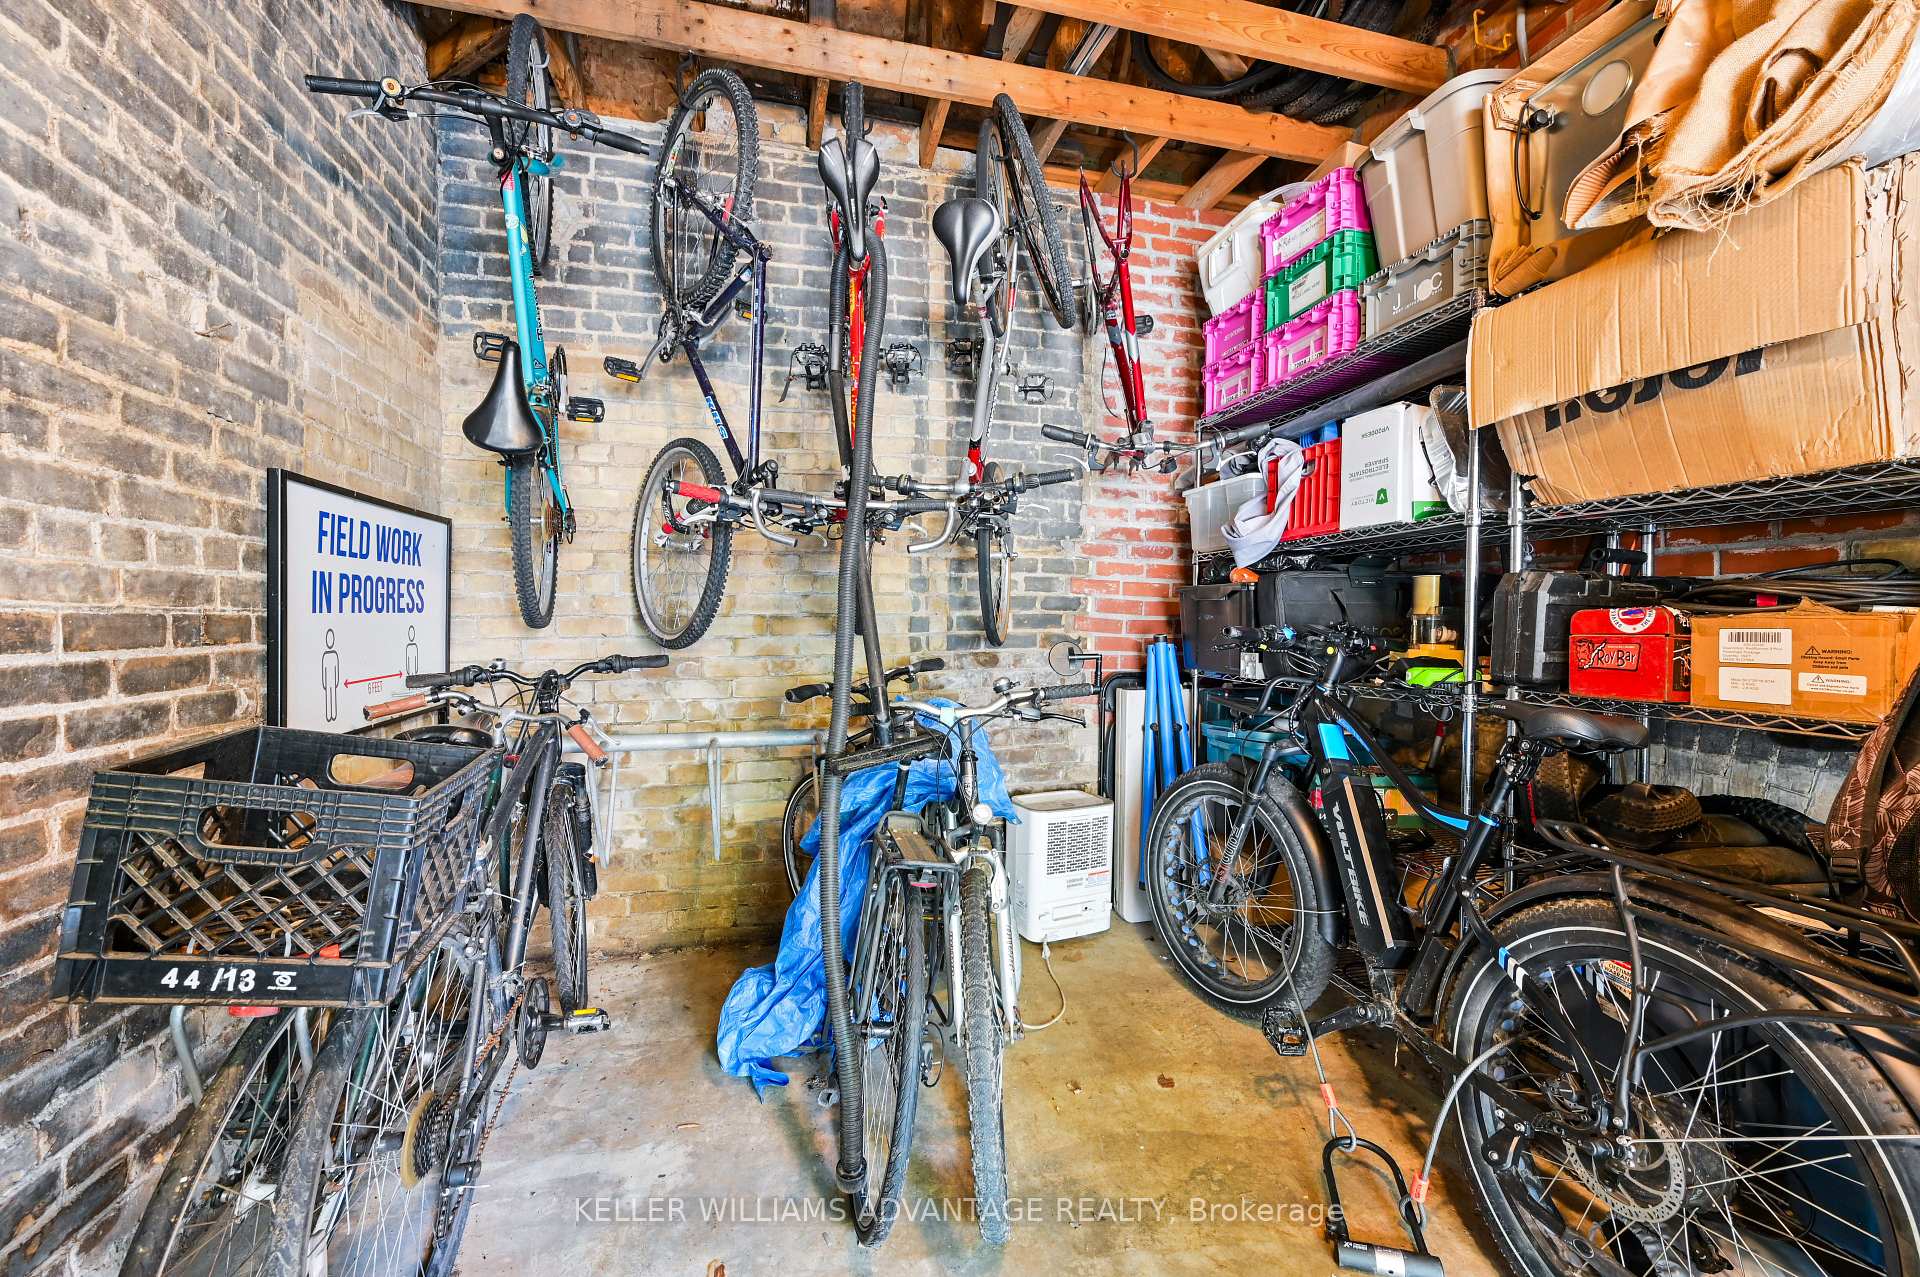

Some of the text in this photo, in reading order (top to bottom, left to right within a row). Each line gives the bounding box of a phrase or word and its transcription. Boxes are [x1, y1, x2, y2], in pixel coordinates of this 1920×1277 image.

[1348, 463, 1389, 479] ELECTROSTATIC
[1364, 457, 1389, 468] SPRAYER
[317, 510, 422, 567] FIELD WORK
[311, 570, 425, 614] IN PROGRESS
